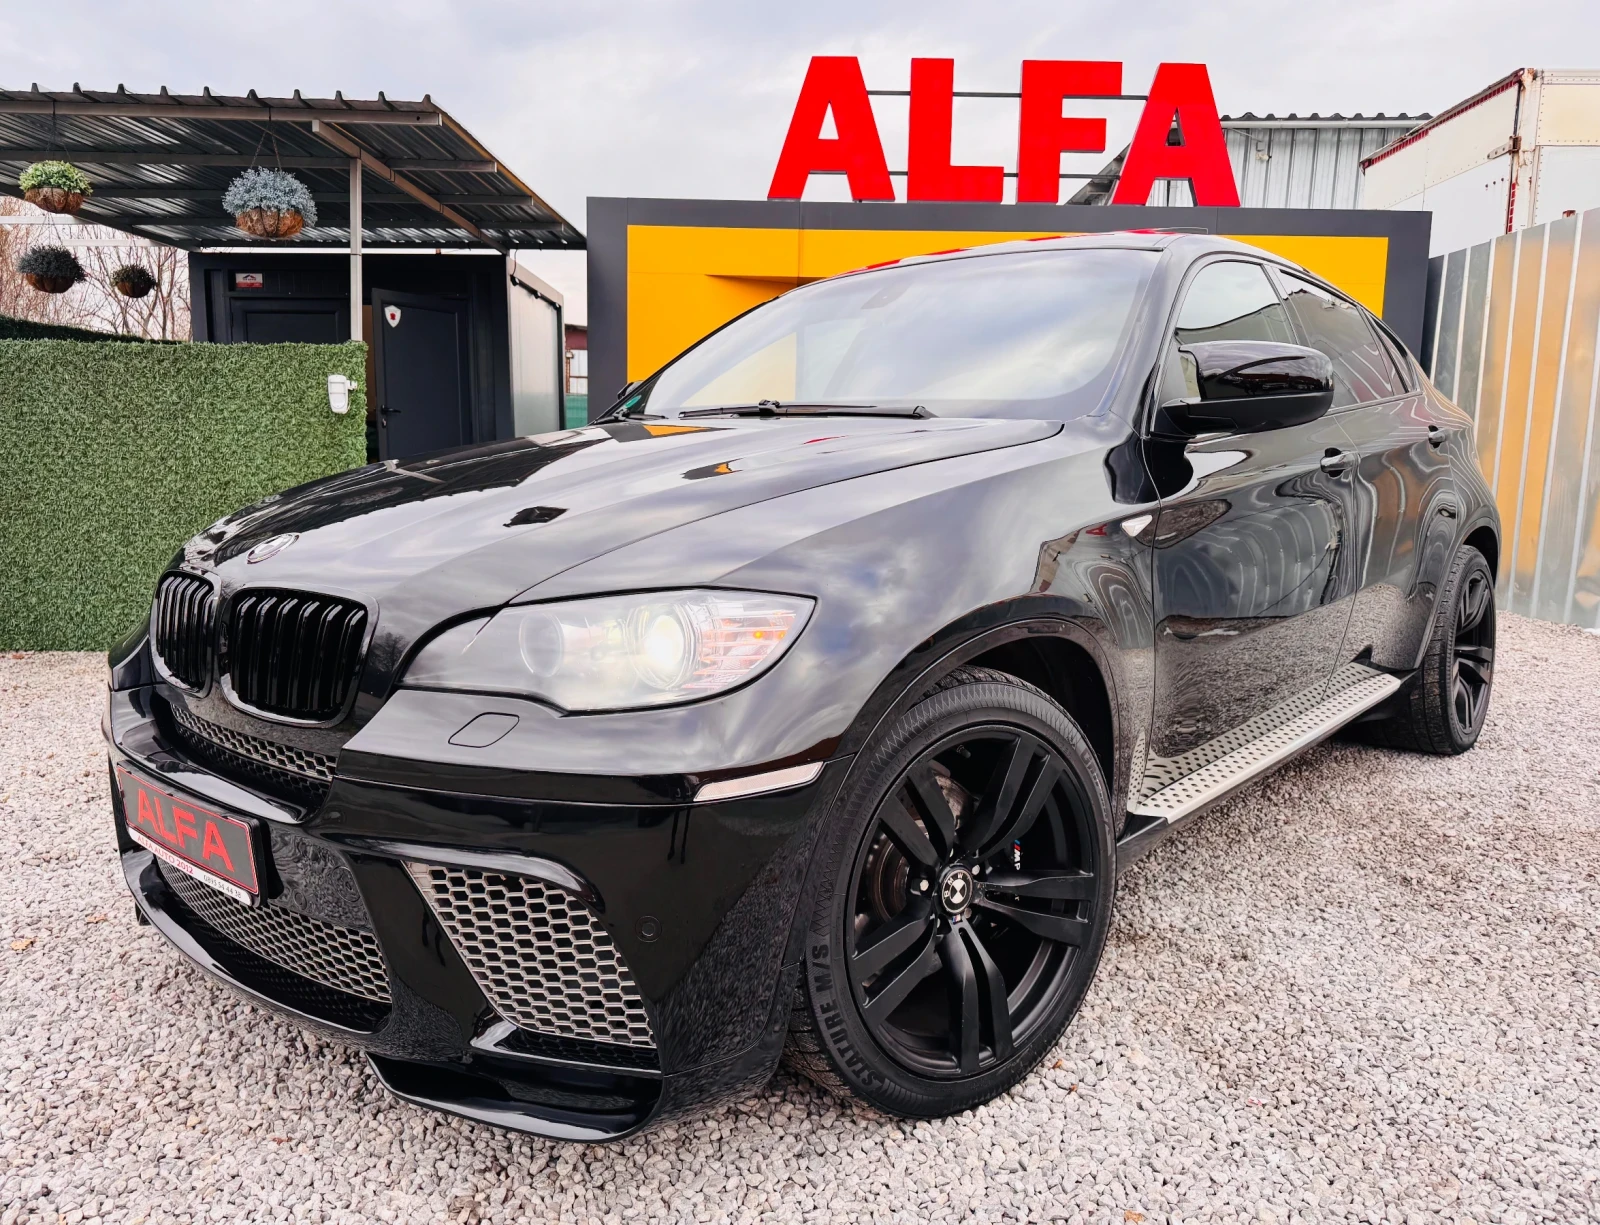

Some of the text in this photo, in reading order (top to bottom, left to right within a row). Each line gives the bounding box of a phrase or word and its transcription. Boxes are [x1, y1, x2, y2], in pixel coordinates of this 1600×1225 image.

[767, 56, 1240, 206] ALFA
[137, 835, 194, 874] ALFA AUTO 2012
[138, 788, 235, 872] ALFA
[812, 944, 833, 993] M/S
[820, 998, 880, 1086] STATURE
